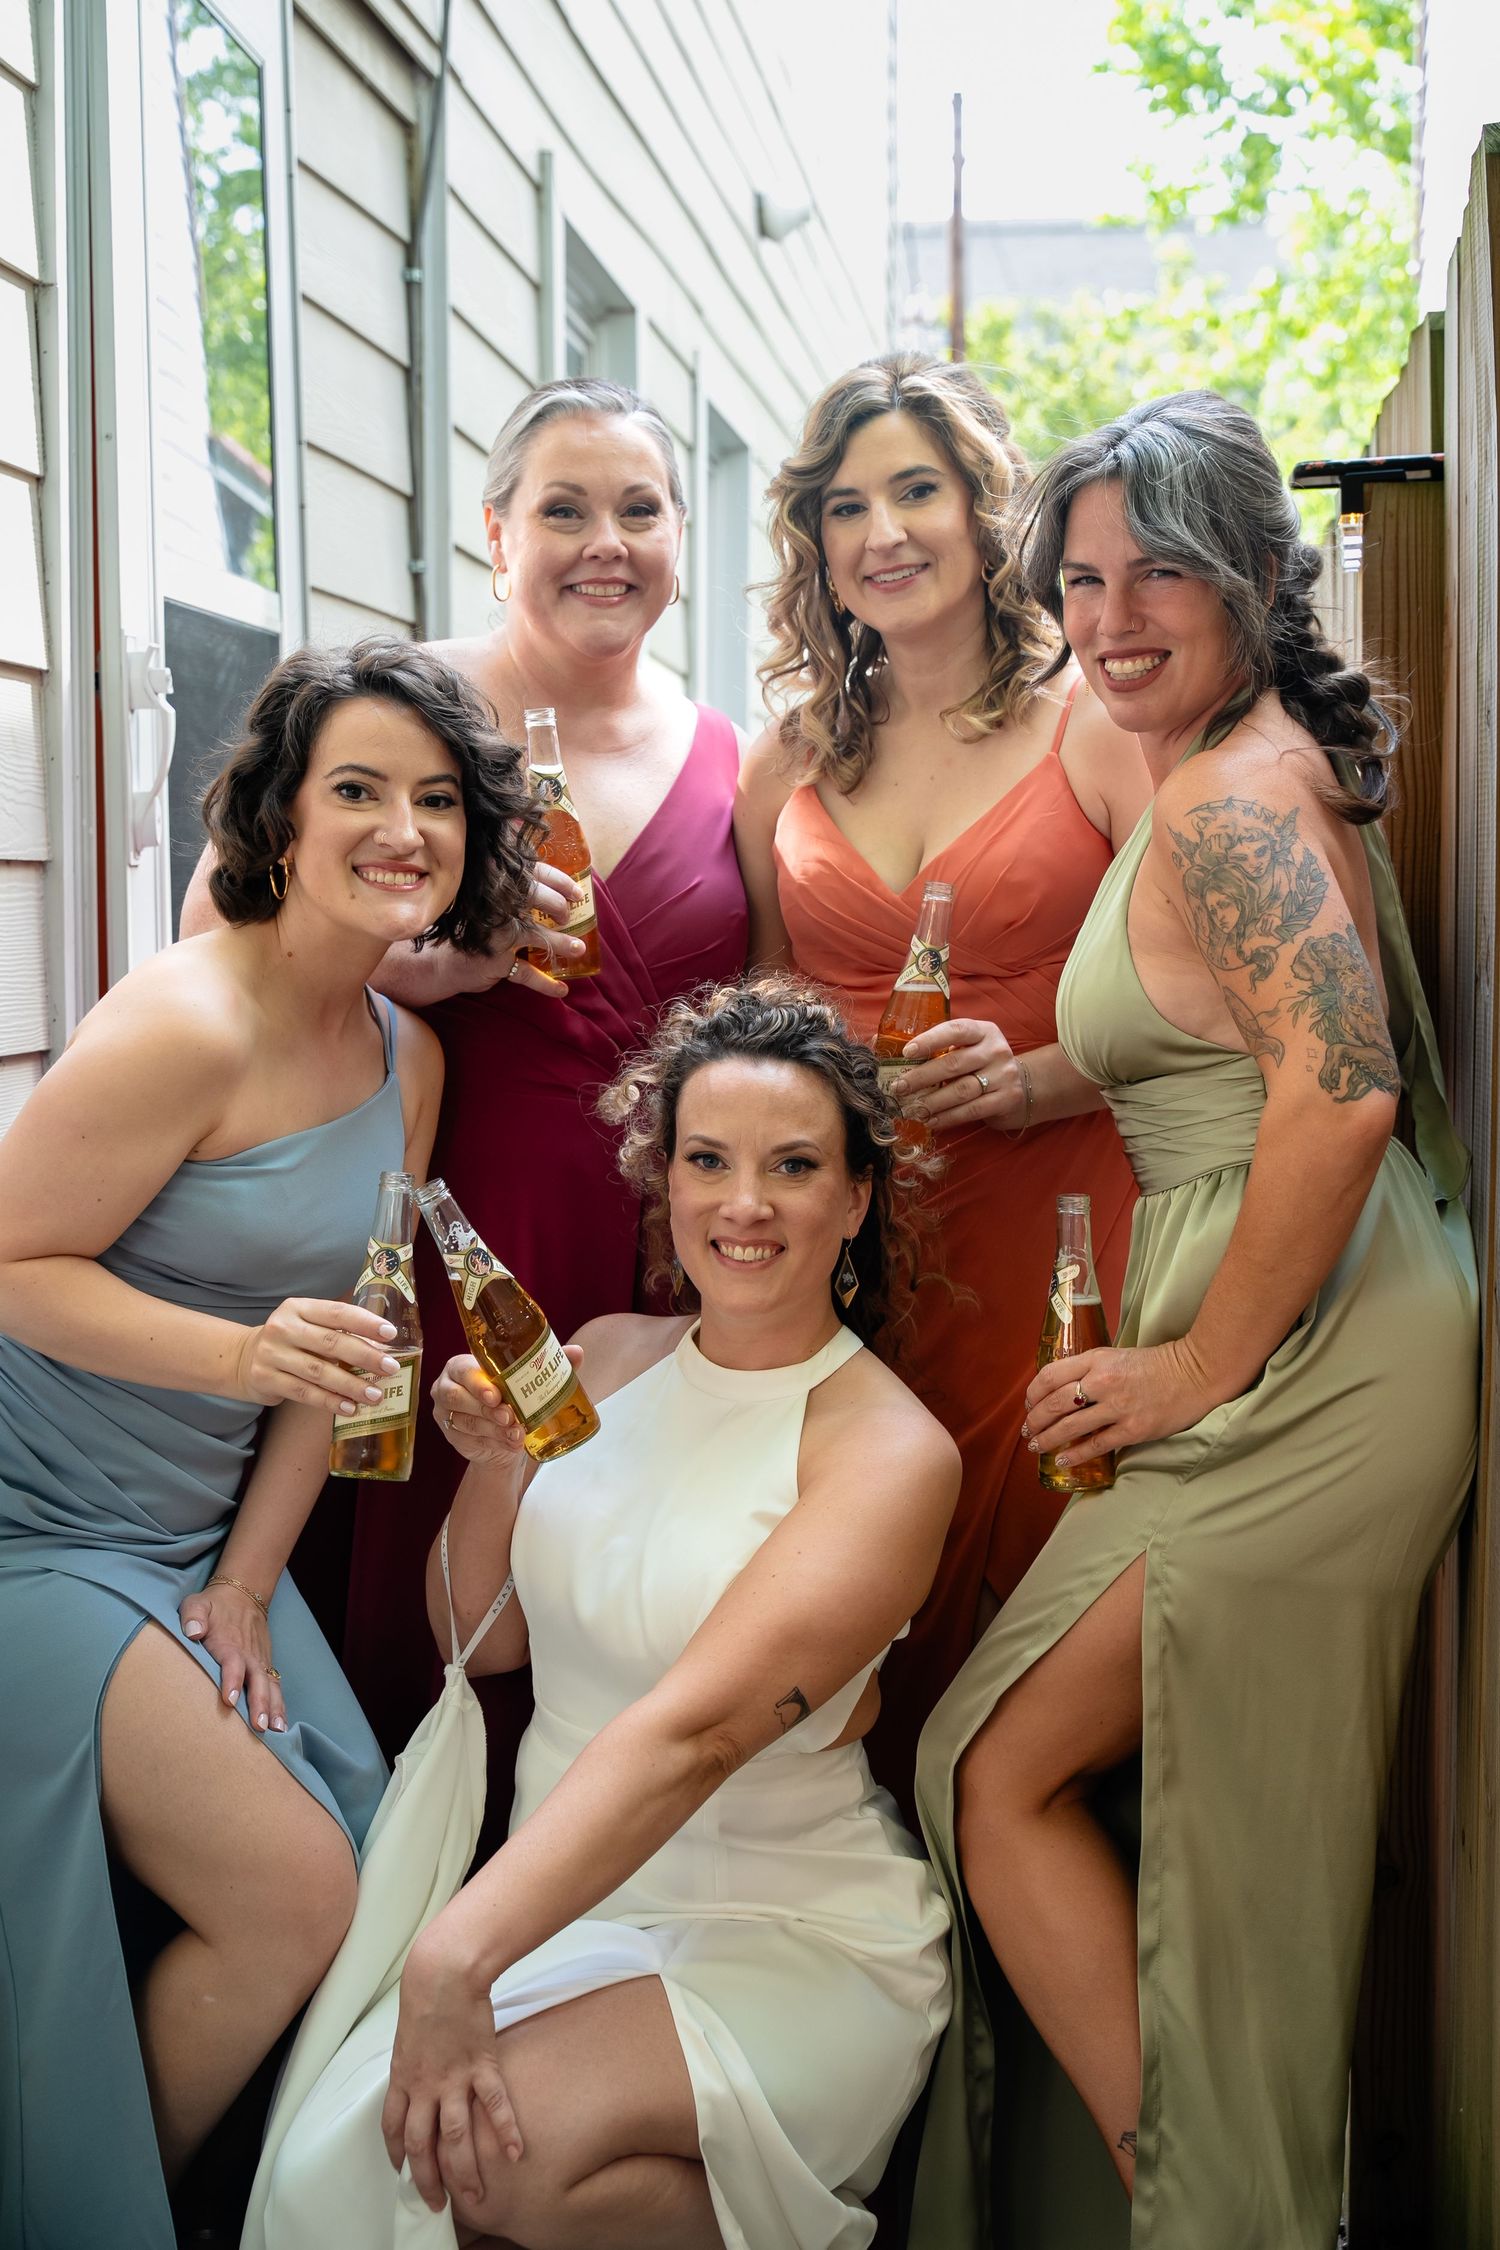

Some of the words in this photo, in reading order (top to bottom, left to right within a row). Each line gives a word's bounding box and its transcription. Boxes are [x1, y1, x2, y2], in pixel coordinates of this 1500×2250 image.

[396, 1276, 410, 1292] LIFE
[466, 1281, 477, 1302] HIGH
[1053, 1297, 1065, 1314] LIFE
[529, 1348, 549, 1373] Miller
[520, 1367, 552, 1399] HIGH
[548, 1348, 565, 1374] LIFE
[383, 1385, 404, 1400] IFE
